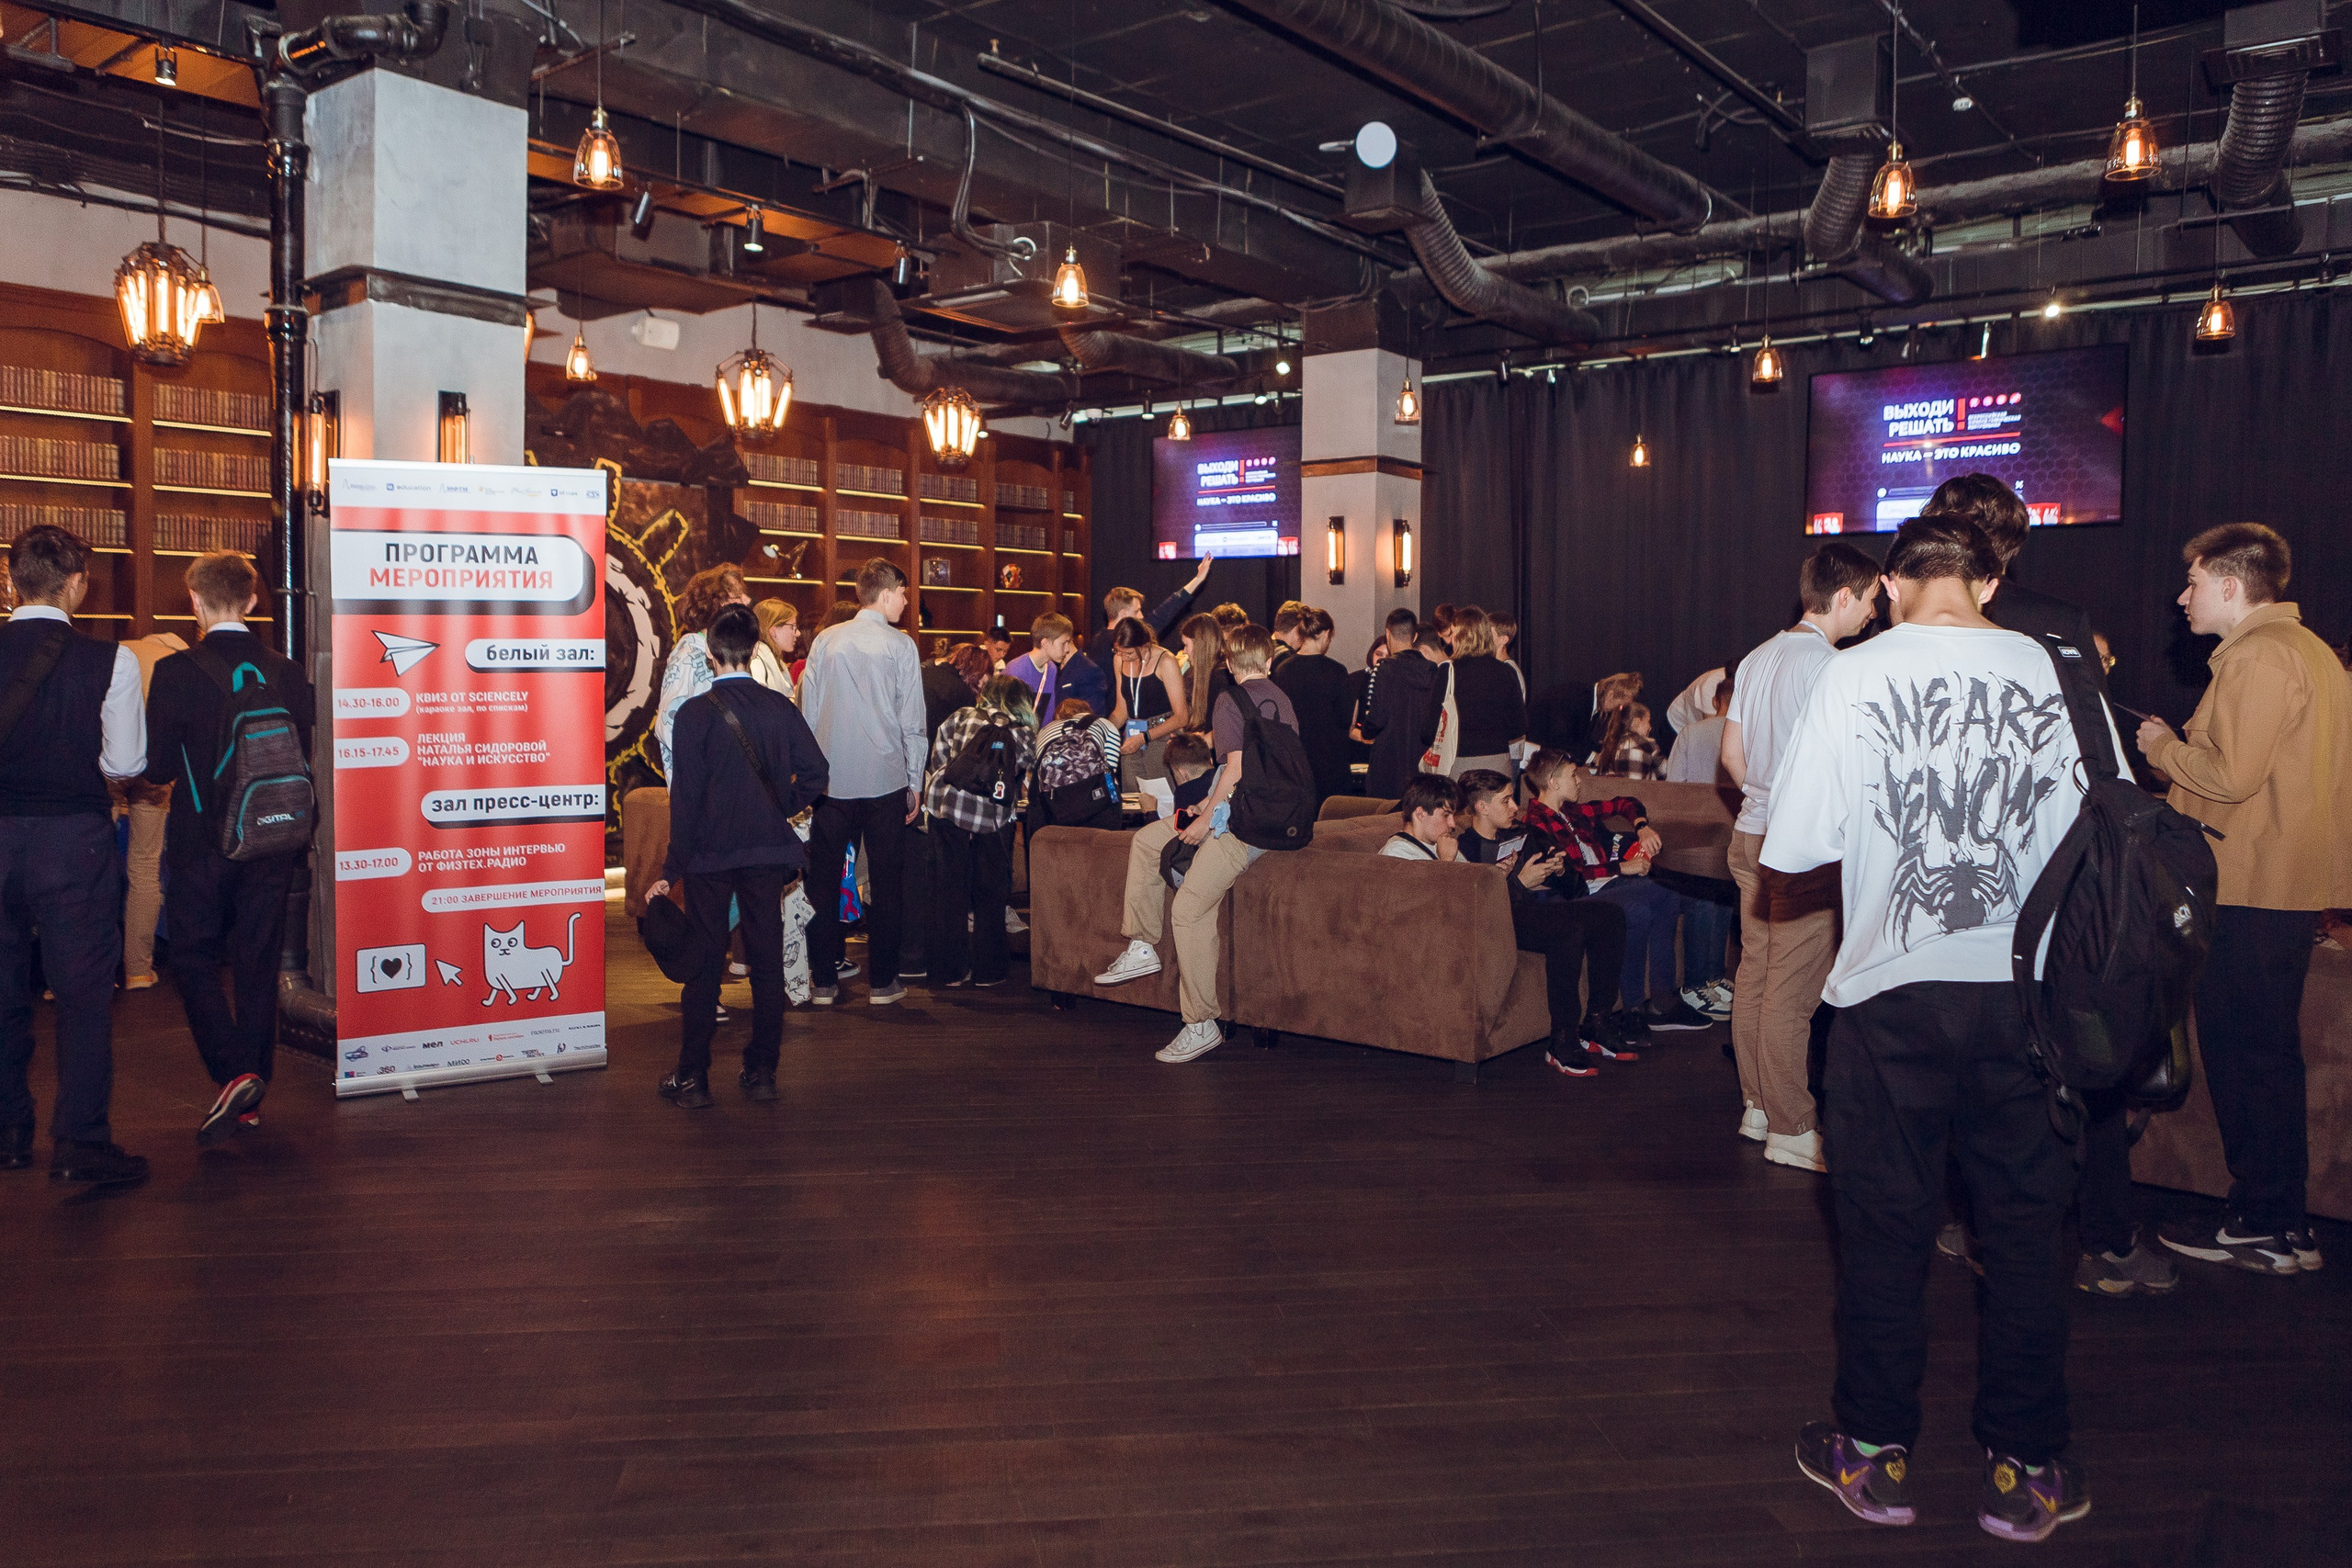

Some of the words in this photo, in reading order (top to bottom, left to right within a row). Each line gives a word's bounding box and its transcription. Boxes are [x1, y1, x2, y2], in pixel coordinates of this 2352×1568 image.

[1883, 399, 1955, 421] ВЫХОДИ
[1888, 417, 1955, 438] РЕШАТЬ
[1881, 450, 1922, 464] НАУКА
[1934, 446, 1960, 460] ЭТО
[1960, 442, 2021, 458] КРАСИВО
[1197, 459, 1239, 475] ВЫХОДИ
[1200, 473, 1239, 488] РЕШАТЬ
[1196, 496, 1221, 506] НАУКА
[1227, 495, 1241, 505] ЭТО
[1241, 492, 1277, 503] КРАСИВО
[385, 542, 539, 565] ПРОГРАММА
[369, 568, 553, 590] МЕРОПРИЯТИЯ
[486, 644, 550, 661] белый
[556, 647, 595, 661] зал:
[337, 696, 401, 709] 14.30-16.00
[415, 692, 447, 704] КВИЗ
[450, 692, 467, 703] ОТ
[469, 691, 528, 703] SCIENCELY
[417, 732, 466, 745] ЛЕКЦИЯ
[337, 746, 401, 760] 16.15-17.45
[416, 744, 472, 756] НАТАЛЬЯ
[474, 739, 547, 755] СИДОРОВОЙ
[466, 754, 475, 765] И
[431, 796, 468, 813] зал
[473, 793, 599, 814] пресс-центр:
[418, 847, 464, 862] РАБОТА
[467, 846, 501, 859] ЗОНЫ
[503, 842, 566, 856] ИНТЕРВЬЮ
[338, 857, 400, 871] 13.30-17.00
[418, 862, 435, 874] ОТ
[436, 856, 527, 872] ФИЗТЕХ.РАДИО
[431, 896, 459, 906] 21:00
[461, 890, 528, 904] ЗАВЕРШЕНИЕ
[530, 886, 602, 898] МЕРОПРИЯТИЯ
